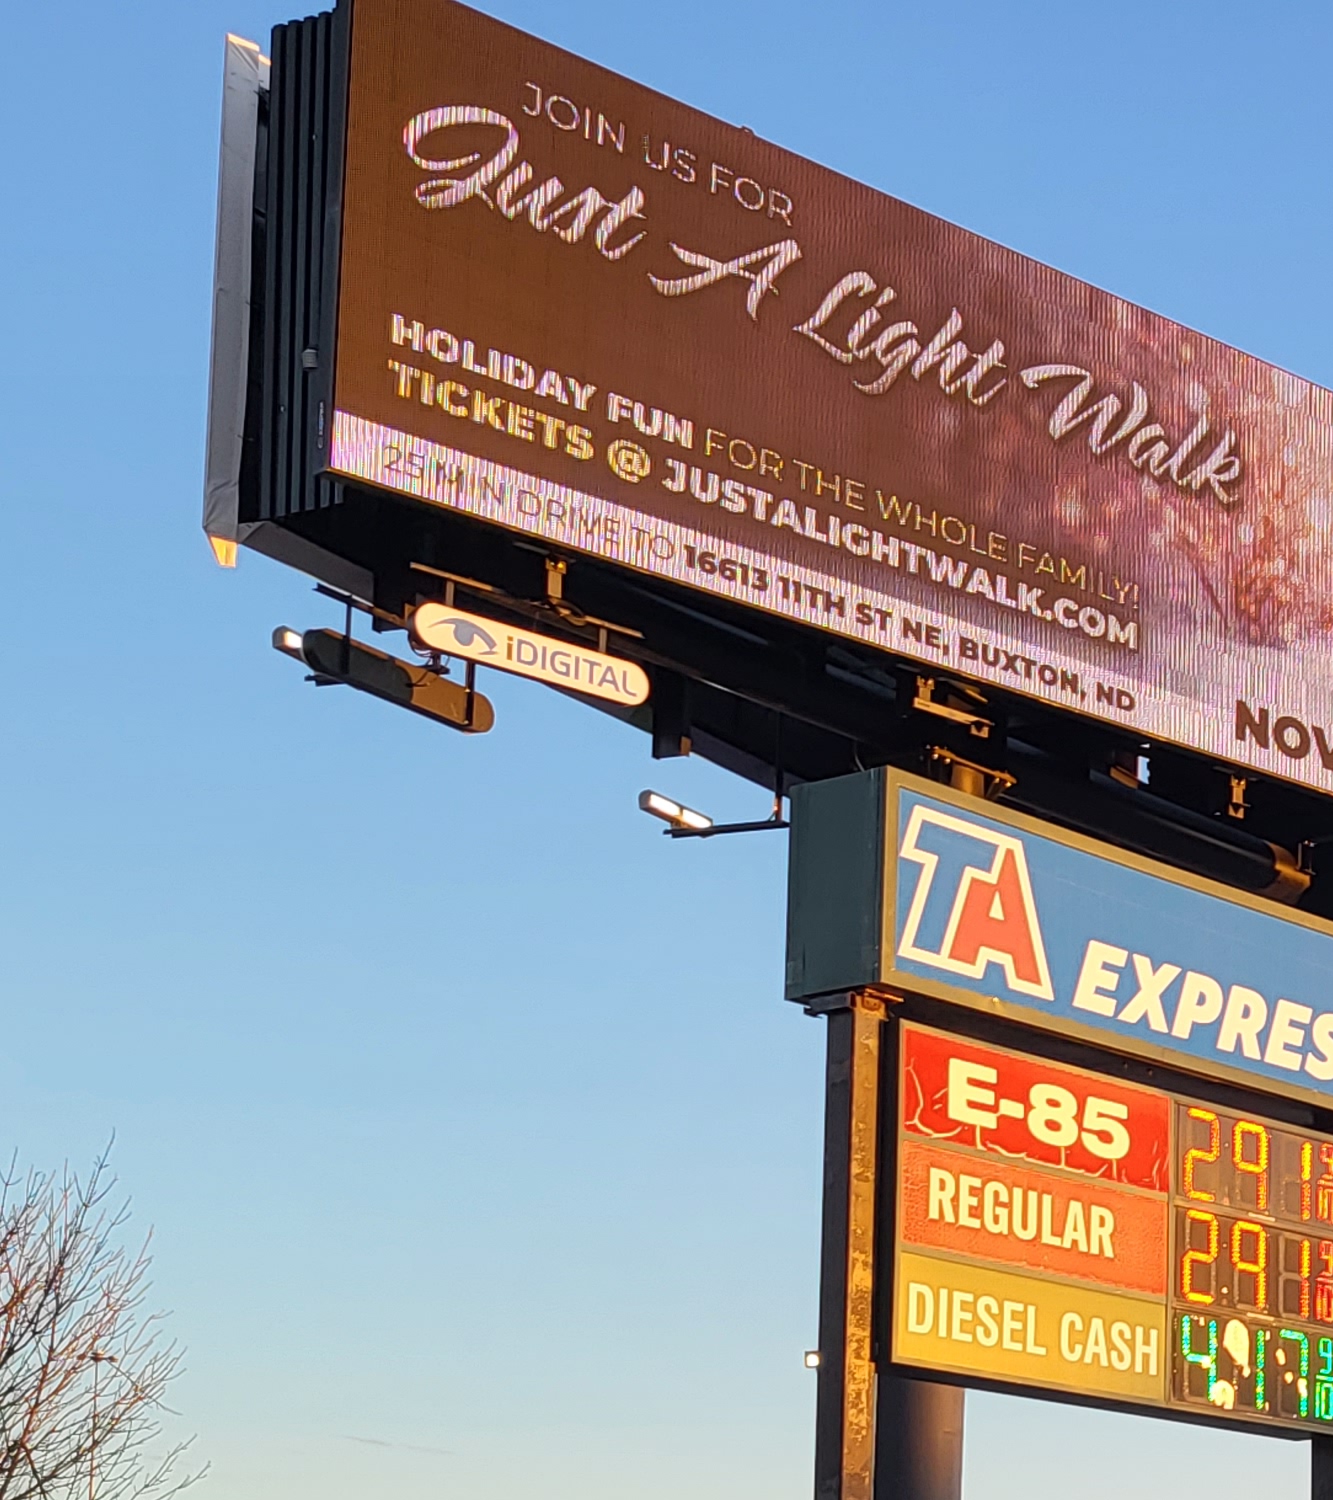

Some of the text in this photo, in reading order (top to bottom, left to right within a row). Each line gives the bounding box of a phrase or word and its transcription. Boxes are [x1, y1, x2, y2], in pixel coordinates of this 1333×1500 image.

[522, 81, 793, 227] JOIN US FOR
[403, 105, 1241, 503] Just A Light Walk
[389, 360, 594, 460] TICKETS
[607, 440, 652, 482] @
[663, 459, 1138, 649] JUSTALIGHTWALK.COM
[391, 313, 1139, 608] HOLIDAY FUN FOR THE WHOLE FAMILY!
[506, 636, 638, 698] iDIGITAL
[630, 526, 674, 559] TO
[684, 543, 770, 591] 16613
[779, 575, 845, 617] 11TH
[856, 602, 893, 635] ST
[902, 618, 949, 655] NE,
[960, 634, 1086, 699] BUXTON,
[1097, 681, 1136, 712] ND
[897, 805, 1055, 1001] TA
[947, 1057, 1131, 1161] E-85
[928, 1167, 1115, 1259] REGULAR
[907, 1281, 1158, 1376] DIESEL CASH
